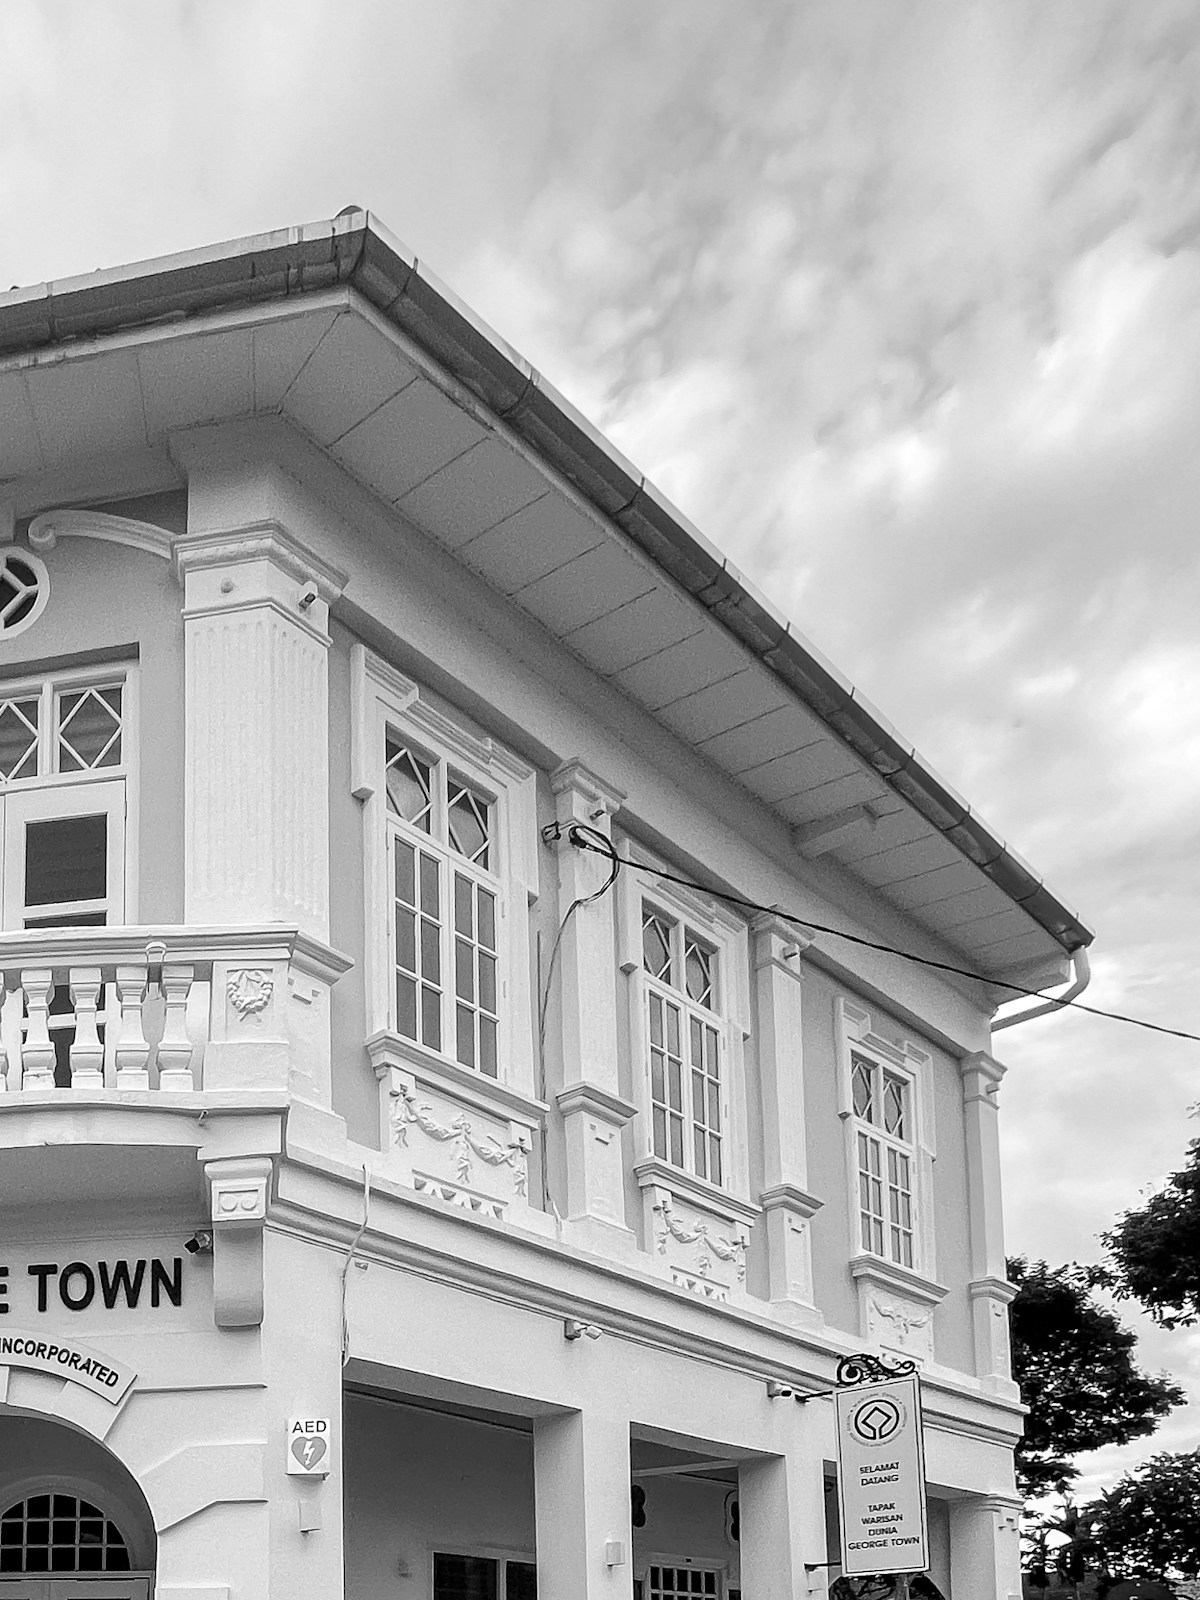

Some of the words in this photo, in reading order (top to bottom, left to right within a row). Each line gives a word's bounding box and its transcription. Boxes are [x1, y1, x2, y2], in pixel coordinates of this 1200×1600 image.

[28, 1257, 182, 1312] TOWN
[292, 1420, 327, 1433] AED
[859, 1462, 900, 1474] SELAMAT
[860, 1475, 899, 1486] DATANG
[867, 1503, 896, 1513] TAPAK
[861, 1514, 904, 1525] WARISAN
[868, 1527, 898, 1536] DUNIA
[847, 1540, 889, 1551] GEORGE
[890, 1536, 920, 1546] TOWN
